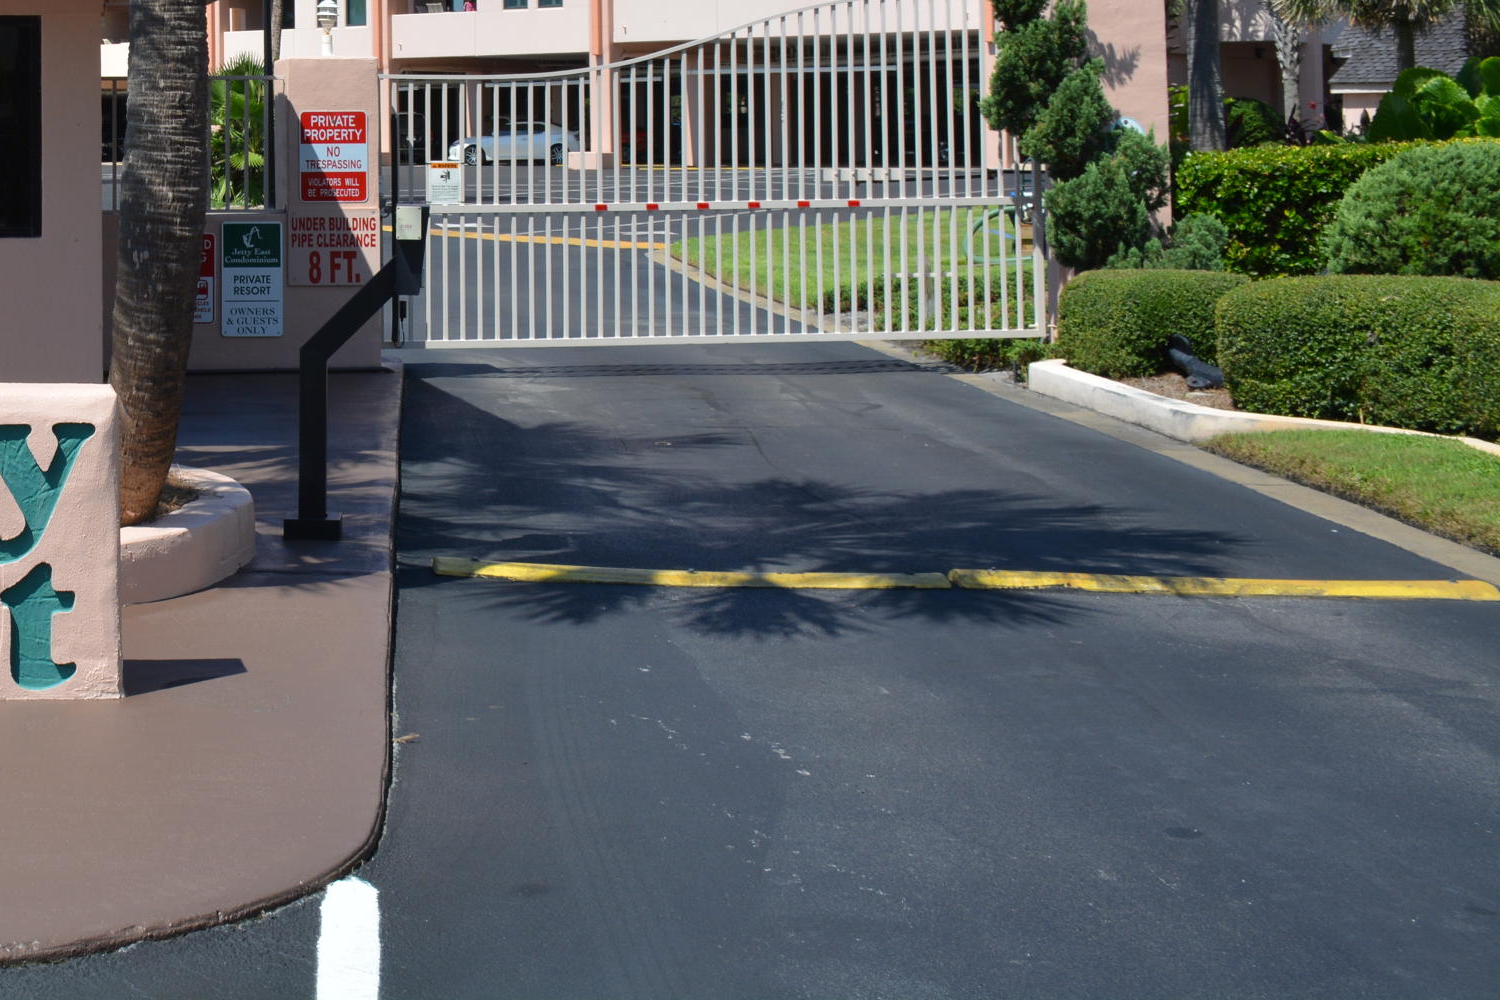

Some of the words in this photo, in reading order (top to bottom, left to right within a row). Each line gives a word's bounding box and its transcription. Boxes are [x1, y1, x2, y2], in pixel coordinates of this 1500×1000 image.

[310, 115, 356, 127] PRIVATE
[303, 129, 362, 141] PROPERTY
[326, 146, 341, 157] NO
[305, 160, 362, 169] TRESPASSING
[307, 177, 342, 187] VIOLATORS
[345, 177, 360, 187] WILL
[307, 188, 317, 197] BE
[320, 188, 360, 197] PROSECUTED
[291, 217, 326, 231] UNDER
[328, 217, 377, 231] BUILDING
[291, 233, 314, 247] PIPE
[316, 233, 377, 247] CLEARANCE
[231, 248, 251, 258] Jetty
[254, 248, 271, 256] East
[224, 256, 279, 264] Condominium
[308, 250, 322, 284] 8
[329, 250, 361, 284] FT.
[233, 274, 272, 284] PRIVATE
[233, 286, 271, 296] RESORT
[230, 307, 275, 316] OWNERS
[226, 317, 234, 325] &
[236, 317, 279, 325] GUESTS
[237, 326, 268, 335] ONLY
